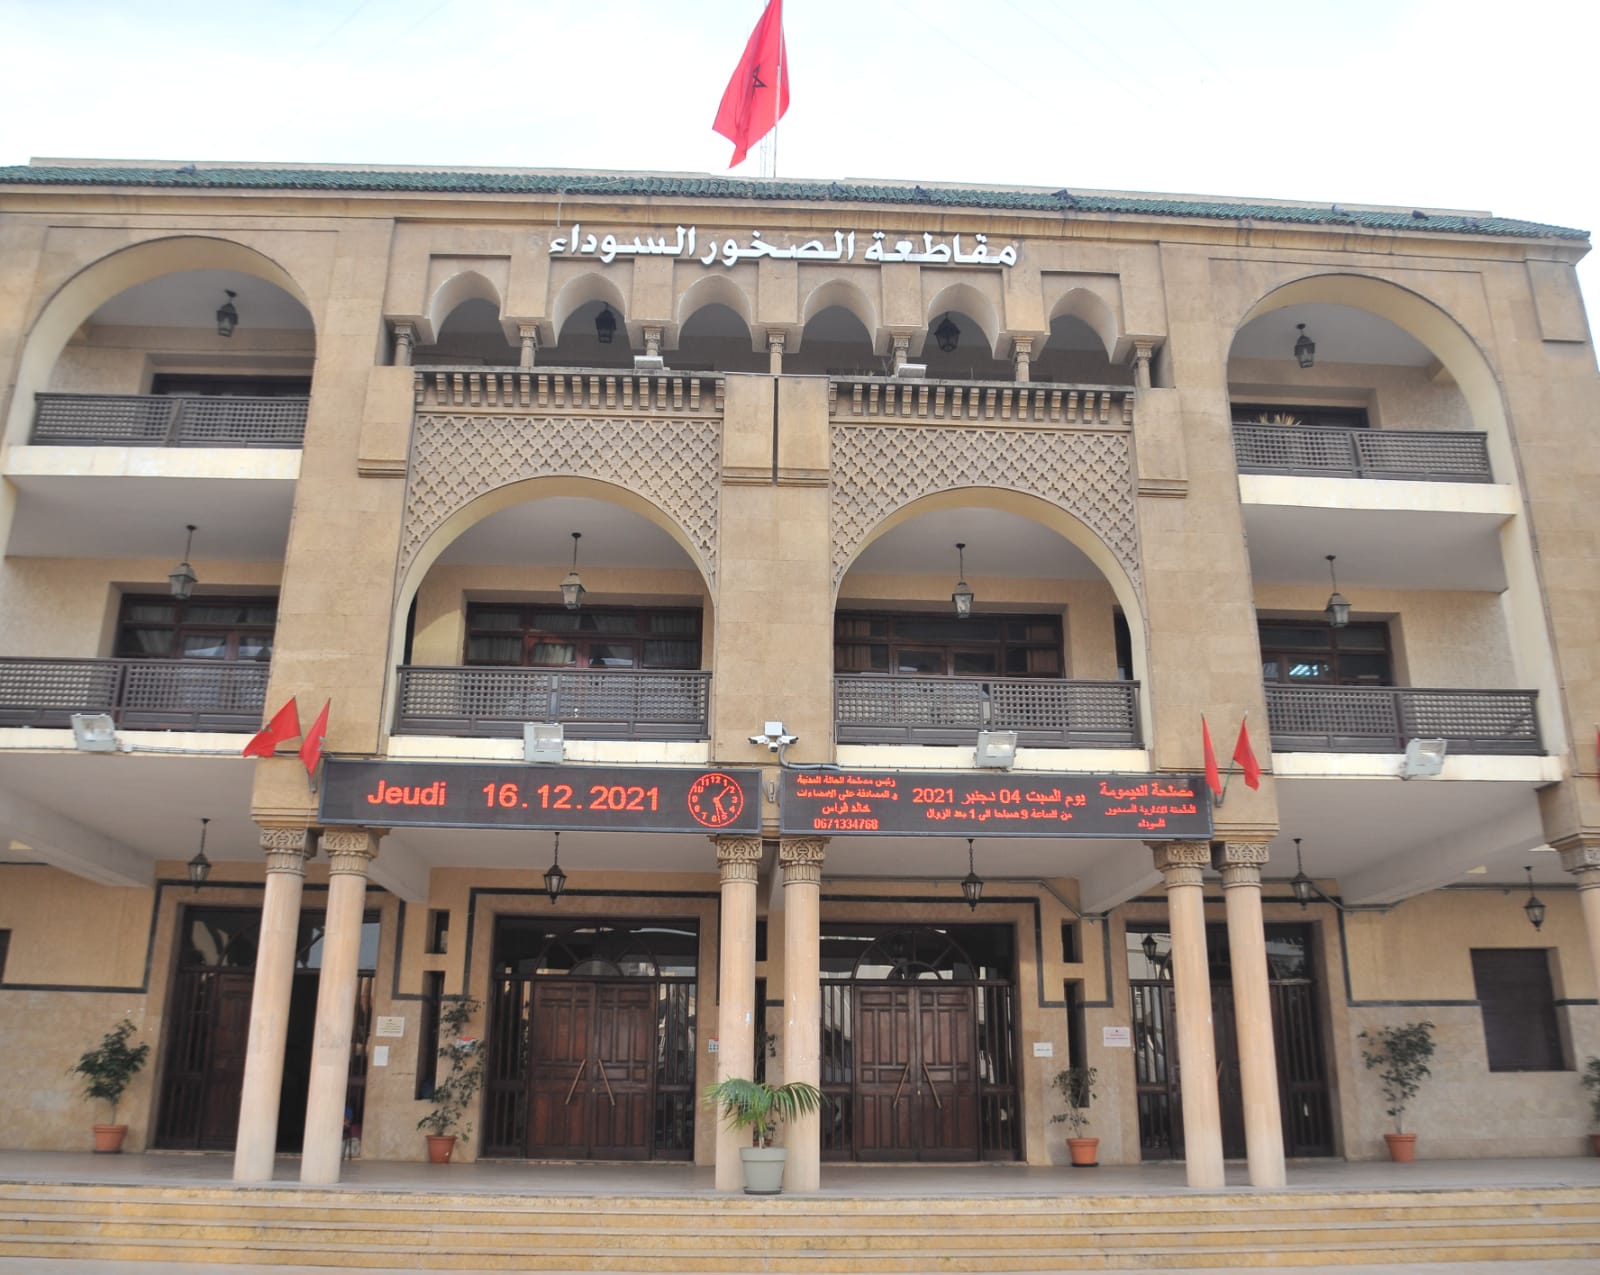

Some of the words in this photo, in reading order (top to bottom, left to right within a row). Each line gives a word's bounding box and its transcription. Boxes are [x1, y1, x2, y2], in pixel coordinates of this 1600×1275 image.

[548, 224, 696, 264] السوداء
[700, 229, 856, 267] الصخور
[864, 231, 1017, 268] مقاطعة
[710, 776, 721, 784] 12
[368, 780, 446, 807] Jeudi
[912, 787, 954, 804] 2021
[961, 790, 996, 805] دجنبر
[1000, 788, 1021, 804] 04
[1026, 788, 1062, 804] السبت
[1100, 782, 1148, 800] الديمومة
[1152, 782, 1194, 798] مصلحة
[1065, 793, 1087, 808] يوم
[970, 808, 975, 818] 1
[1020, 808, 1028, 819] 9
[1031, 808, 1058, 818] الساعة
[1060, 810, 1072, 821] من
